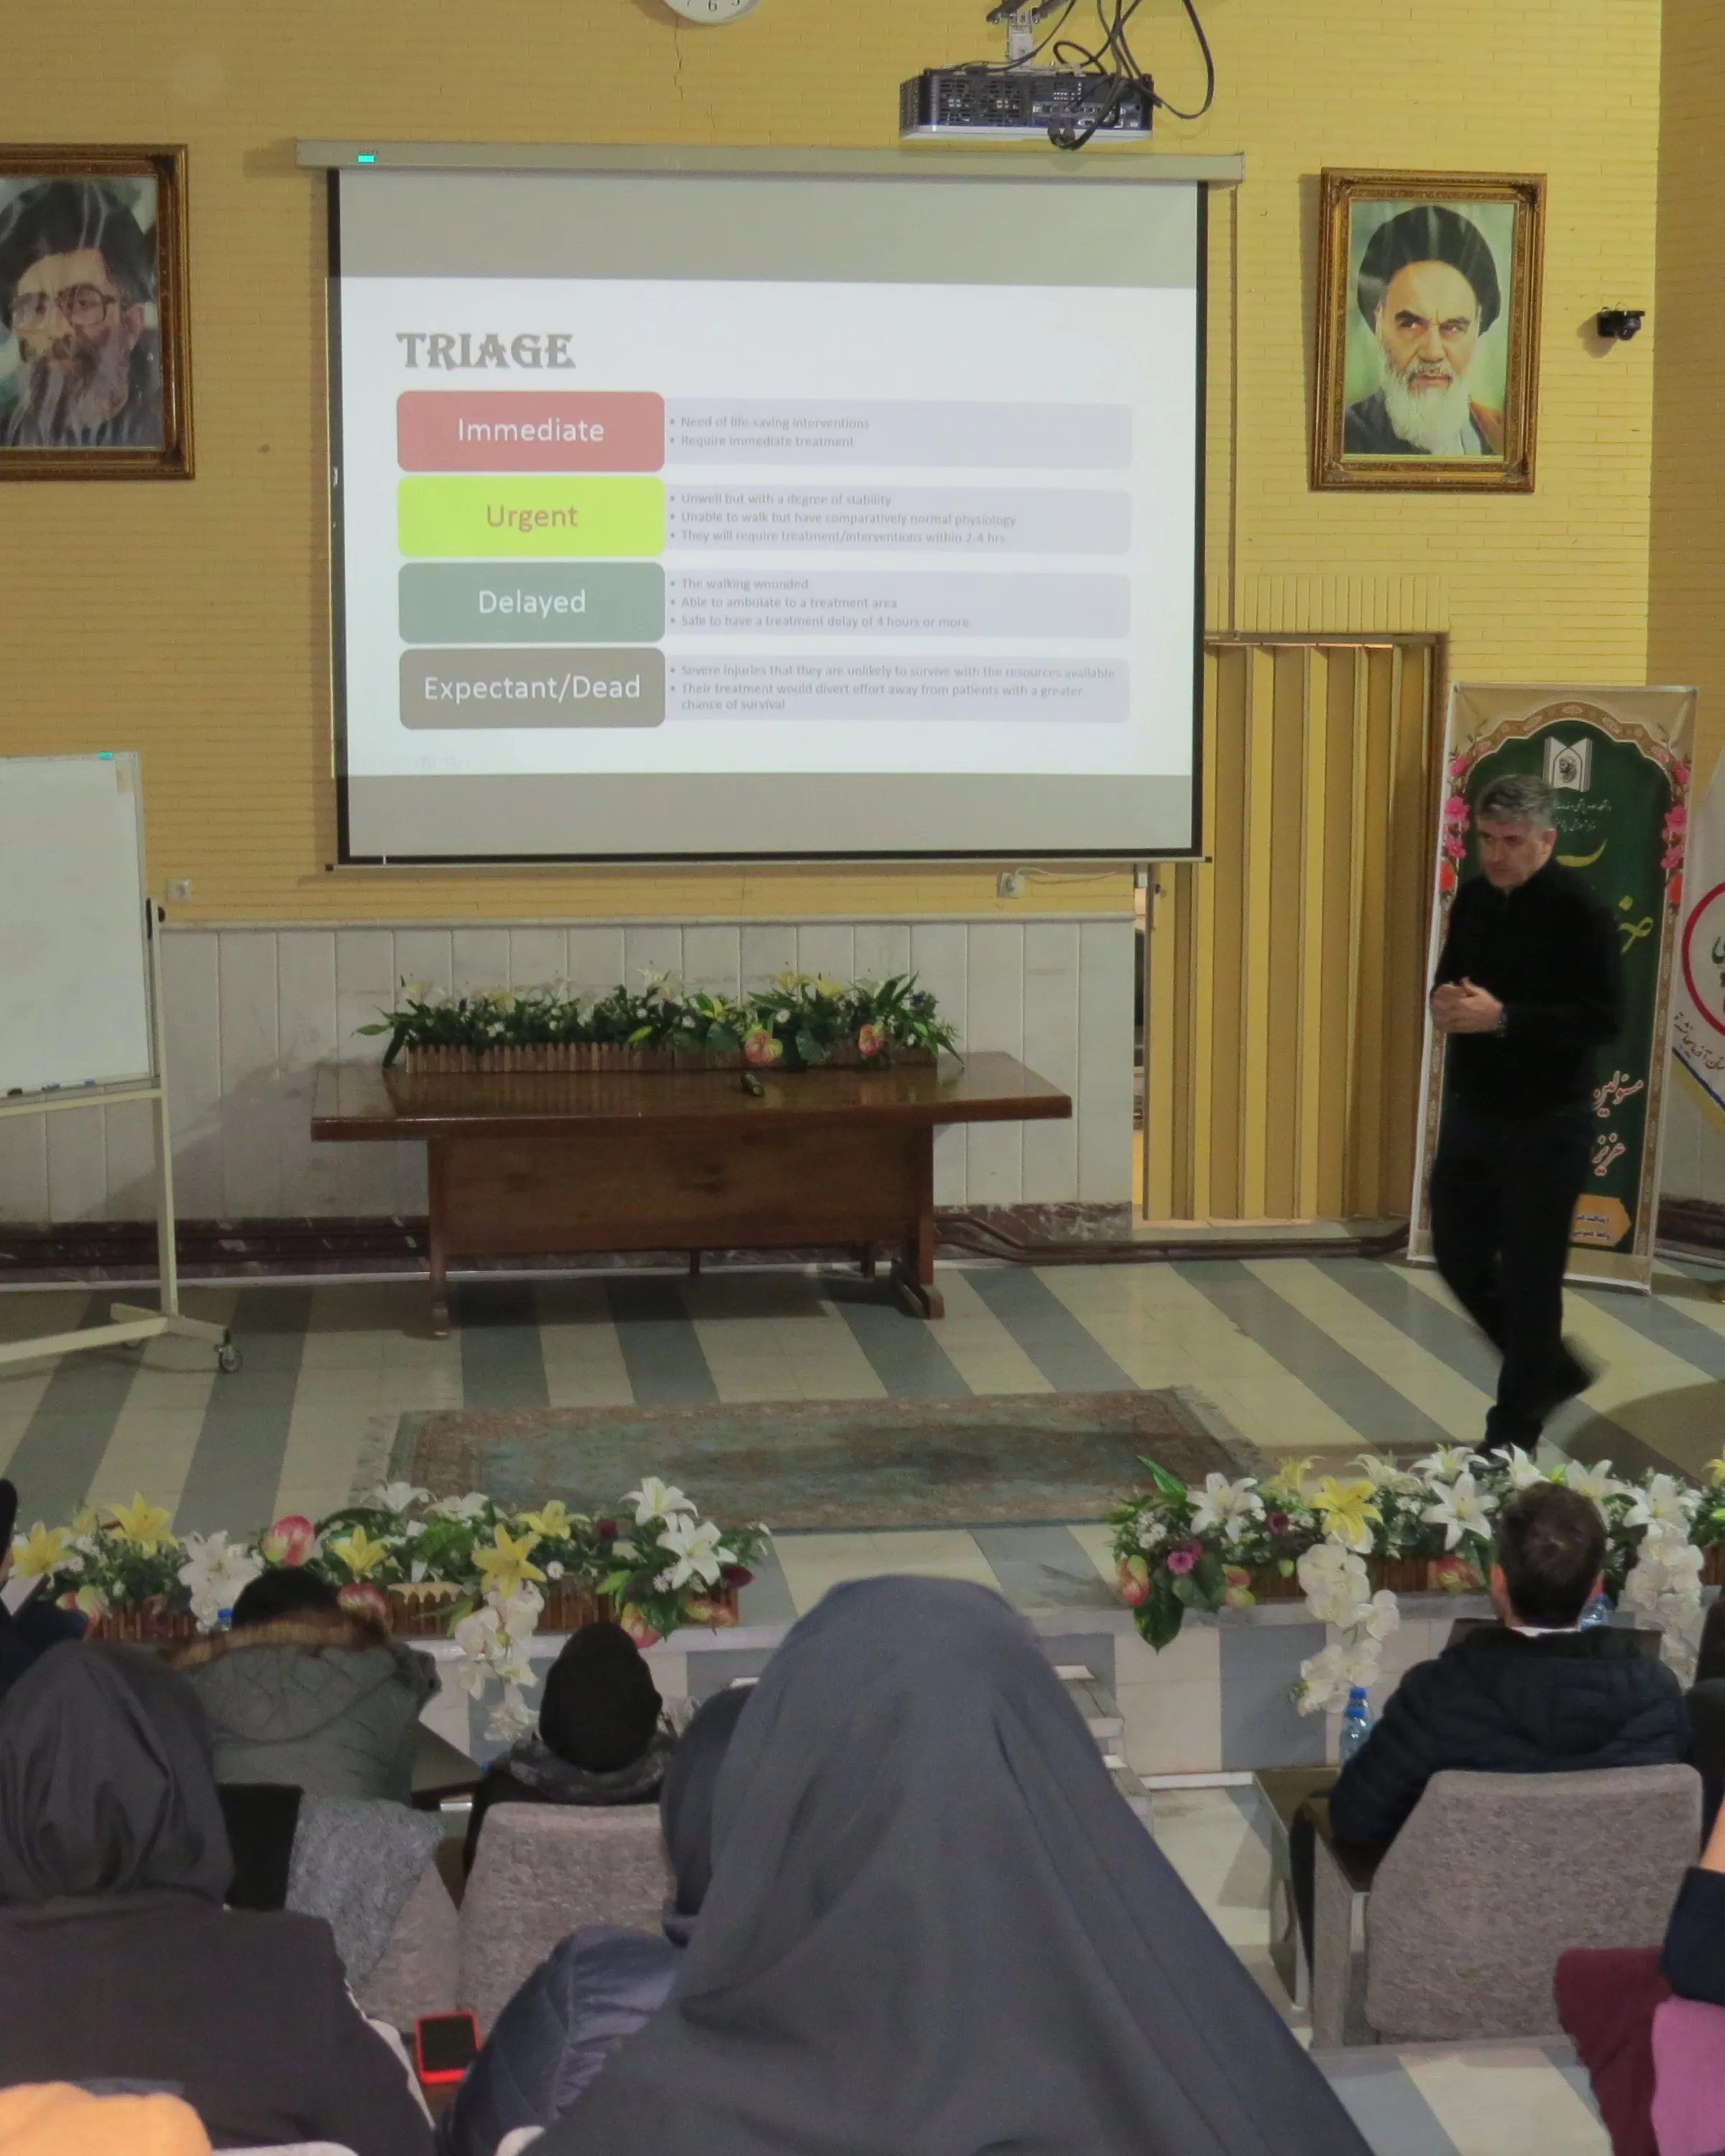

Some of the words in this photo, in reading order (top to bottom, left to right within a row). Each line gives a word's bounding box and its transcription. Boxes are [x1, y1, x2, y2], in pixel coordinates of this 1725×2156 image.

[395, 332, 576, 370] TRIAGE
[681, 418, 712, 427] Need
[716, 417, 727, 427] of
[793, 418, 870, 430] interventions
[457, 418, 604, 443] Immediate
[681, 436, 726, 448] Require
[730, 436, 792, 447] immediate
[795, 436, 853, 447] treatment
[681, 494, 722, 505] Unwell
[724, 494, 744, 505] but
[748, 494, 773, 505] with
[778, 496, 783, 505] a
[787, 494, 827, 507] degree
[831, 494, 842, 505] of
[847, 494, 891, 507] stability
[487, 505, 579, 533] Urgent
[681, 512, 722, 522] Unable
[727, 513, 737, 522] to
[742, 512, 768, 522] walk
[772, 512, 791, 522] but
[794, 512, 822, 522] have
[825, 513, 907, 527] comparatively
[910, 514, 952, 525] normal
[955, 514, 1016, 528] physiology
[681, 530, 709, 543] They
[713, 530, 732, 541] will
[736, 531, 777, 543] require
[926, 532, 962, 543] within
[681, 579, 703, 589] The
[706, 579, 750, 591] walking
[754, 579, 809, 590] wounded
[479, 589, 586, 618] Delayed
[681, 596, 707, 607] Able
[712, 598, 722, 607] to
[726, 598, 781, 608] ambulate
[785, 599, 796, 608] to
[811, 599, 868, 609] treatment
[681, 616, 706, 626] Safe
[709, 617, 721, 626] to
[724, 616, 752, 626] have
[765, 617, 824, 627] treatment
[827, 616, 858, 629] delay
[861, 616, 873, 627] of
[877, 617, 883, 627] 4
[887, 617, 919, 627] hours
[923, 619, 934, 627] or
[681, 665, 720, 675] Severe
[724, 665, 766, 677] injuries
[770, 665, 792, 675] that
[796, 665, 822, 678] they
[847, 665, 891, 678] unlikely
[896, 666, 906, 677] to
[911, 667, 950, 677] survive
[954, 666, 979, 677] with
[983, 667, 1002, 677] the
[1006, 669, 1061, 678] resources
[1064, 667, 1115, 678] available
[424, 673, 640, 705] Expectant/Dead
[681, 683, 712, 694] Their
[715, 683, 773, 694] treatment
[777, 683, 812, 694] would
[816, 683, 848, 694] divert
[852, 683, 885, 694] effort
[888, 686, 917, 697] away
[921, 684, 948, 695] from
[952, 686, 999, 697] patients
[1003, 686, 1027, 695] with
[1041, 686, 1082, 698] greater
[681, 699, 722, 709] chance
[726, 699, 737, 709] of
[741, 699, 785, 710] survival
